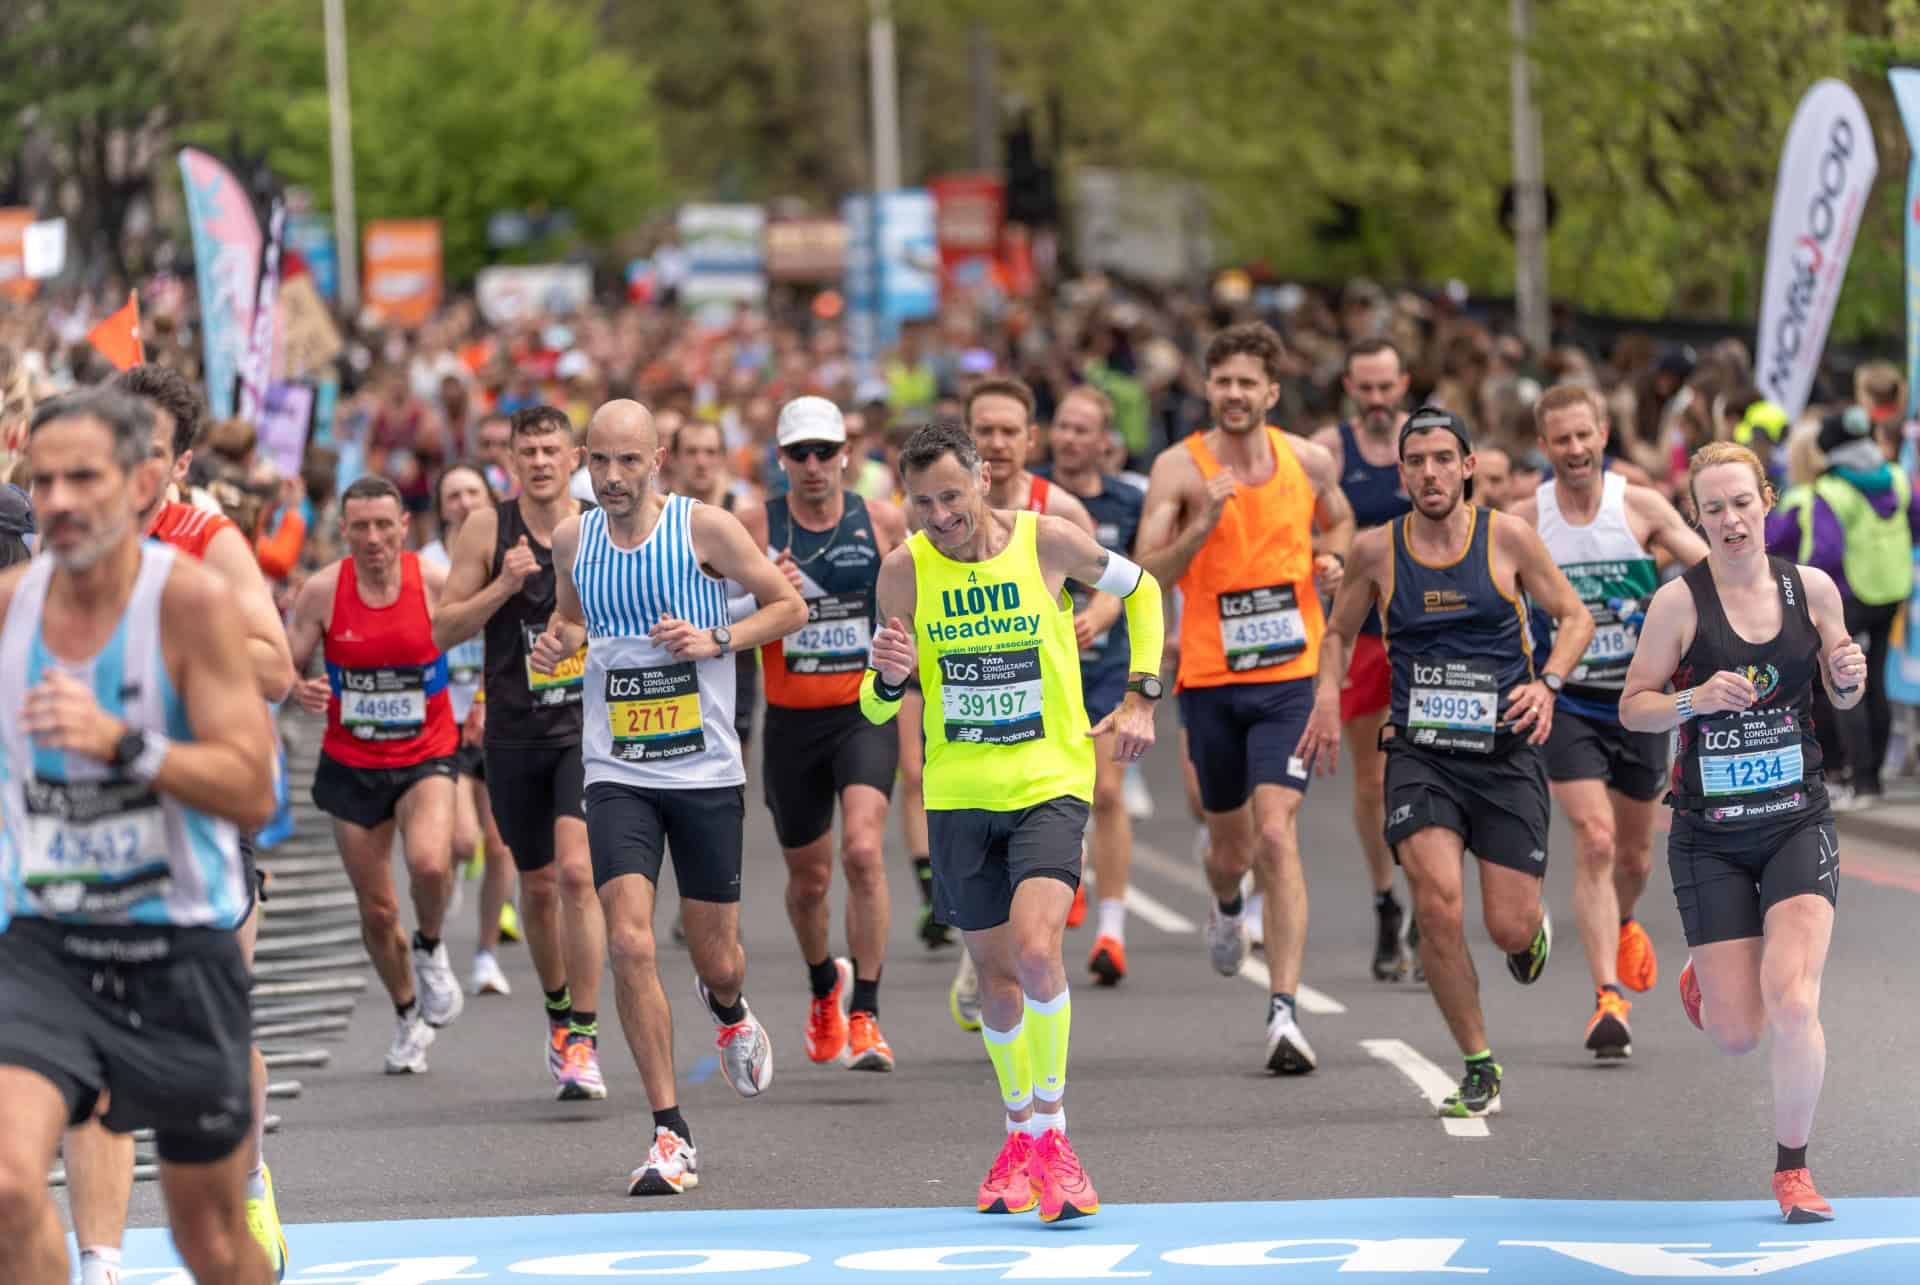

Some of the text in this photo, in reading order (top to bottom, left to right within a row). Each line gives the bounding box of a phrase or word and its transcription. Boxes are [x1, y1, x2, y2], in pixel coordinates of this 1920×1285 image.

[967, 570, 978, 585] 4
[1781, 574, 1796, 607] soar
[942, 582, 1021, 618] LLOYD
[926, 614, 1041, 643] Headway
[797, 627, 858, 649] 42406
[995, 638, 1043, 650] association
[981, 656, 1004, 665] TATA
[982, 660, 1034, 673] CONSULTANCY
[642, 671, 664, 679] TATA
[945, 659, 979, 681] tcs
[982, 671, 1016, 681] SERVICES
[1413, 662, 1444, 686] tcs
[610, 674, 641, 696] tcs
[643, 674, 692, 687] CONSULTANCY
[643, 685, 677, 695] SERVICES
[958, 690, 1028, 717] 39197
[1421, 695, 1482, 721] 49993
[627, 705, 680, 733] 2717
[1743, 721, 1767, 730] TATA
[1001, 729, 1036, 743] balance
[1705, 729, 1741, 751] tcs
[1744, 725, 1794, 739] CONSULTANCY
[1744, 736, 1779, 747] SERVICES
[645, 751, 663, 759] new
[663, 744, 698, 757] balance
[1726, 757, 1784, 788] 1234
[1746, 799, 1800, 816] new balance
